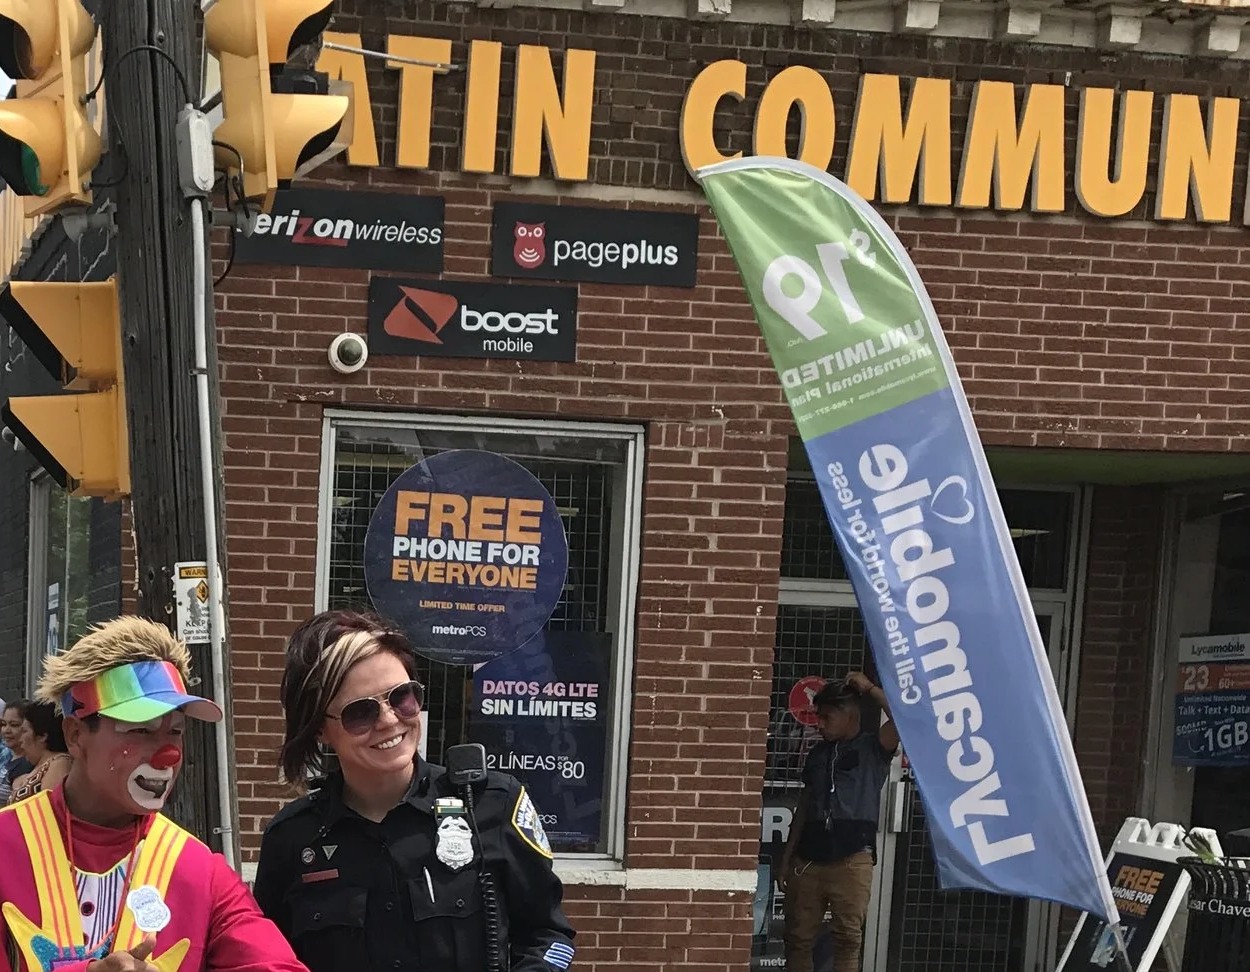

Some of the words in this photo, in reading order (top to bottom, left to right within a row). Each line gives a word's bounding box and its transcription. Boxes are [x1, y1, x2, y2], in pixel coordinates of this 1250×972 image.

[317, 31, 596, 182] ATIN
[680, 59, 1250, 224] COMMUN
[553, 238, 679, 268] pageplus
[460, 304, 560, 336] boost
[482, 336, 535, 353] mobile
[393, 489, 544, 545] FREE
[392, 536, 482, 563] PHONE
[486, 542, 541, 566] FOR
[184, 568, 207, 576] WARN
[391, 559, 538, 590] EVERYONE
[419, 600, 453, 610] LIMITED
[455, 602, 476, 611] TIME
[477, 603, 506, 613] OFFER
[432, 624, 487, 637] metroPCS
[1191, 640, 1246, 657] Lycamobile
[482, 679, 540, 696] DATOS
[542, 681, 566, 697] 4G
[569, 683, 599, 698] LTE
[481, 698, 514, 716] SIN
[517, 696, 597, 718] LÍMITES
[1178, 705, 1197, 716] Talk
[1204, 705, 1223, 716] Text
[1204, 720, 1249, 752] 1GB
[486, 754, 496, 769] 2
[499, 751, 556, 771] LÍNEAS
[557, 760, 585, 779] $80
[1114, 865, 1165, 895] FREE
[1111, 886, 1137, 901] PHONE
[1135, 891, 1155, 905] FOR
[1208, 898, 1250, 918] Chave
[759, 957, 787, 967] metr
